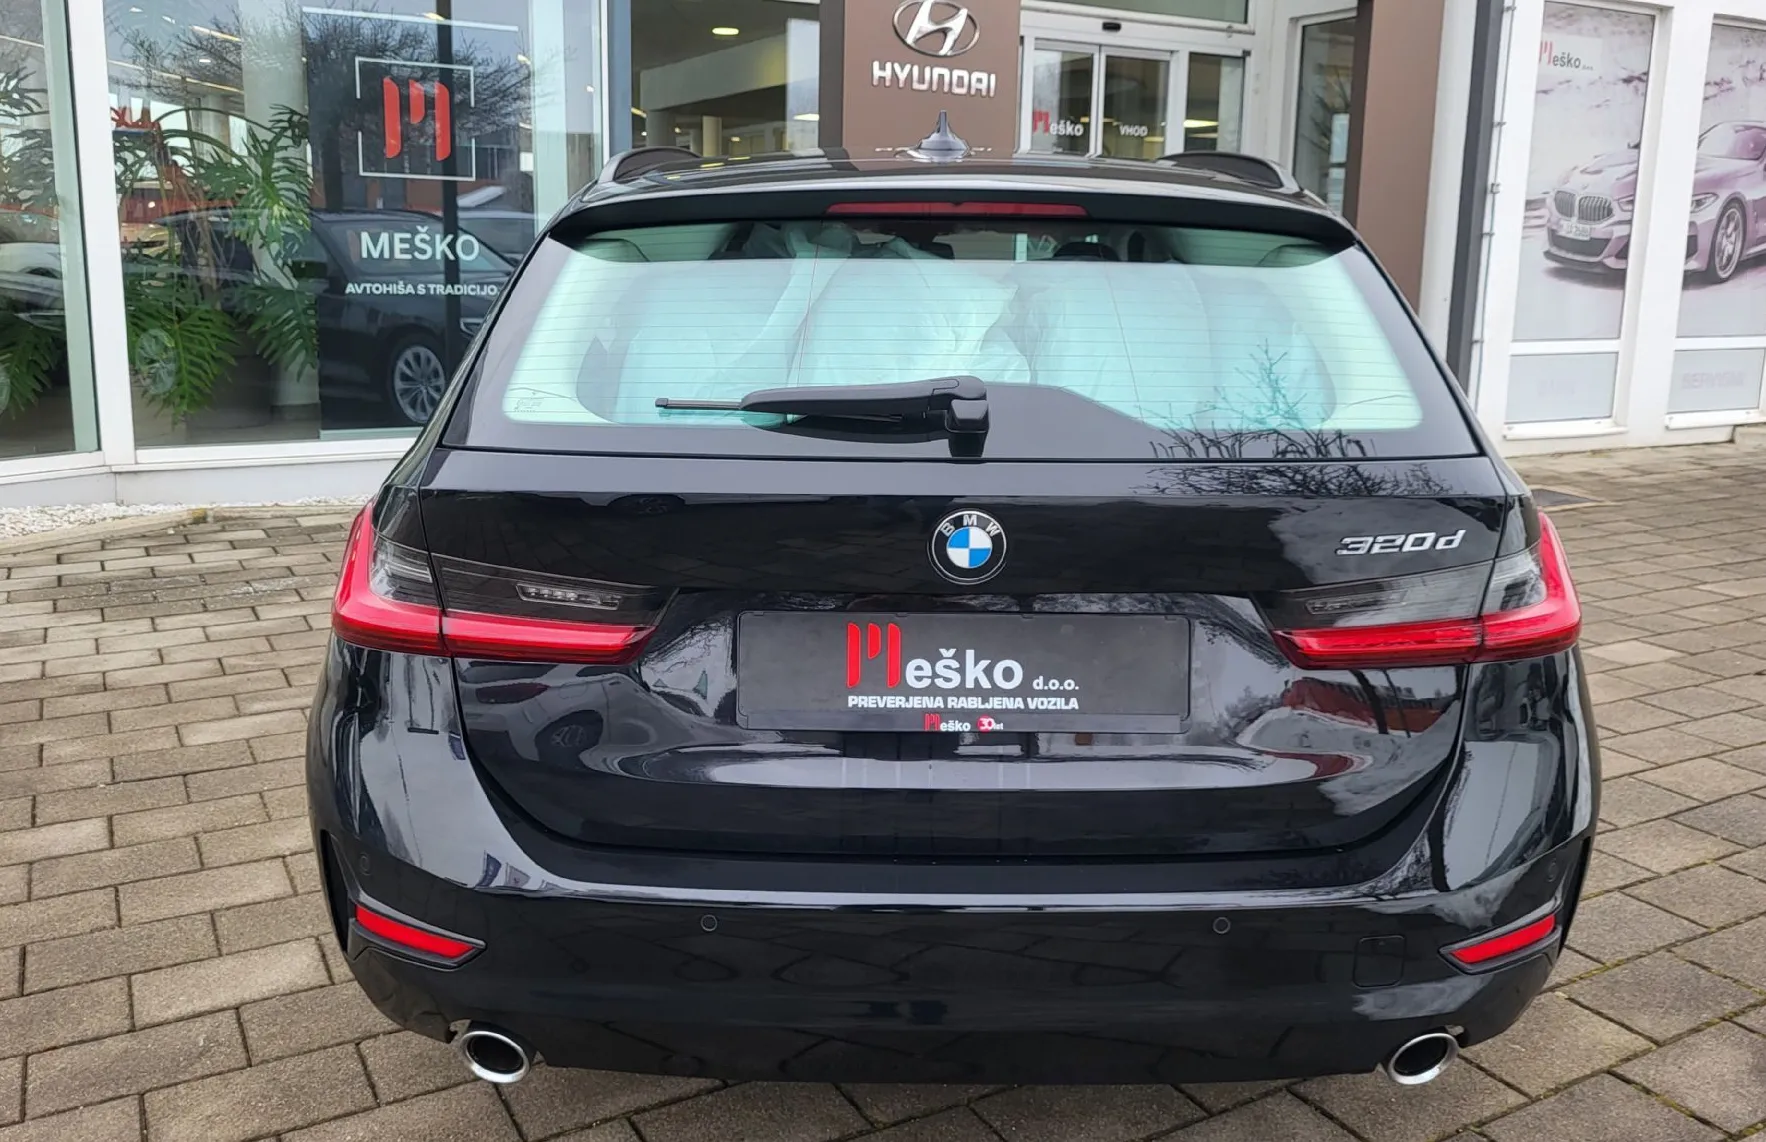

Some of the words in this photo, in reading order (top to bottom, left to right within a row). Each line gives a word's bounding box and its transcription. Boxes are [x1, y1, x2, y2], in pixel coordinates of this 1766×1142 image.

[872, 60, 996, 98] HYUNDAI
[1032, 109, 1084, 136] Meško
[1119, 125, 1148, 136] VHOD
[360, 225, 480, 261] MEŠKO
[345, 281, 415, 295] AVTOHIŠA
[417, 283, 426, 295] S
[940, 514, 1001, 537] BMW
[1336, 529, 1466, 555] 320d
[846, 623, 1024, 690] Meško
[1032, 676, 1080, 690] d.o.o.
[848, 696, 944, 708] PREVERJENA
[947, 697, 1024, 709] RABLJENA
[1026, 698, 1079, 709] VOZILA
[924, 713, 971, 731] Meško
